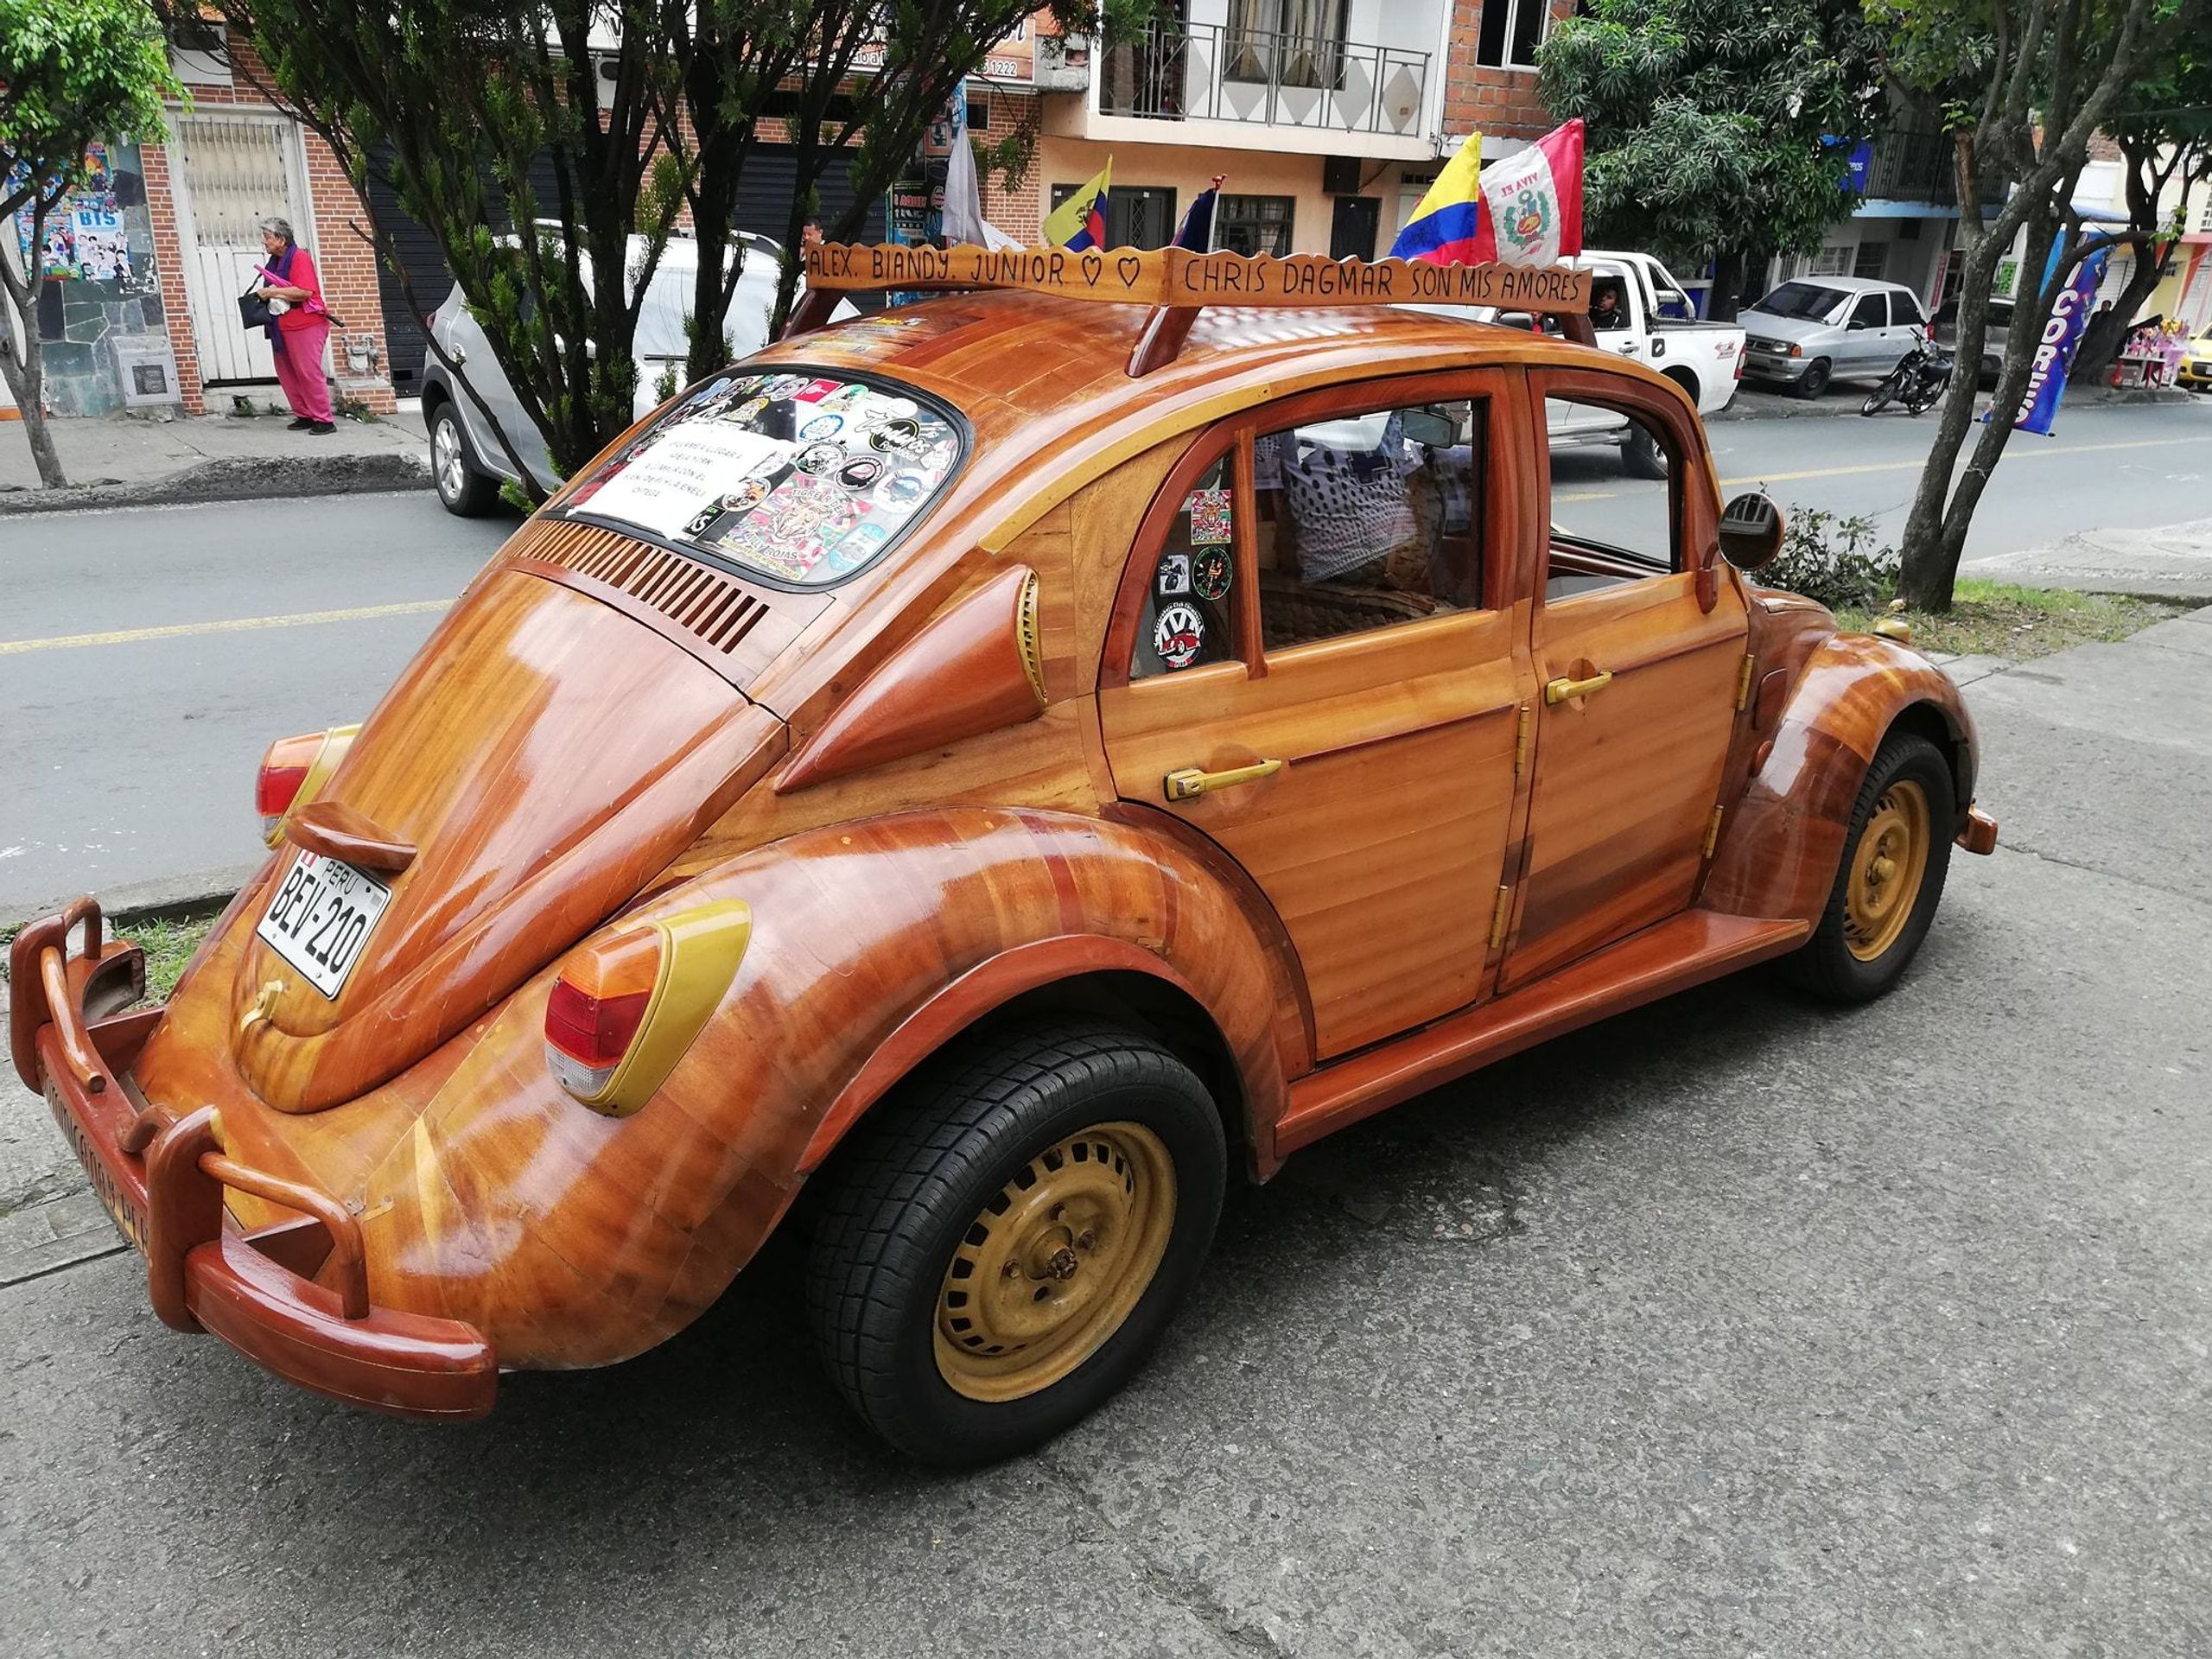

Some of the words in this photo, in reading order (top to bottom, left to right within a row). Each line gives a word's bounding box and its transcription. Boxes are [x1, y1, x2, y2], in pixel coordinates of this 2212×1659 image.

[991, 60, 1017, 76] 1222
[79, 212, 116, 226] BTS
[970, 254, 1065, 284] JUNIOR
[1185, 259, 1266, 292] CHRIS
[1283, 264, 1393, 296] DAGMAR
[1411, 267, 1451, 297] SON
[1459, 270, 1491, 298] MIS
[1501, 269, 1580, 302] AMORES
[792, 489, 822, 499] TIGRE
[765, 546, 798, 560] ROJAS
[321, 860, 359, 895] PERU
[269, 866, 366, 975] BEV-210
